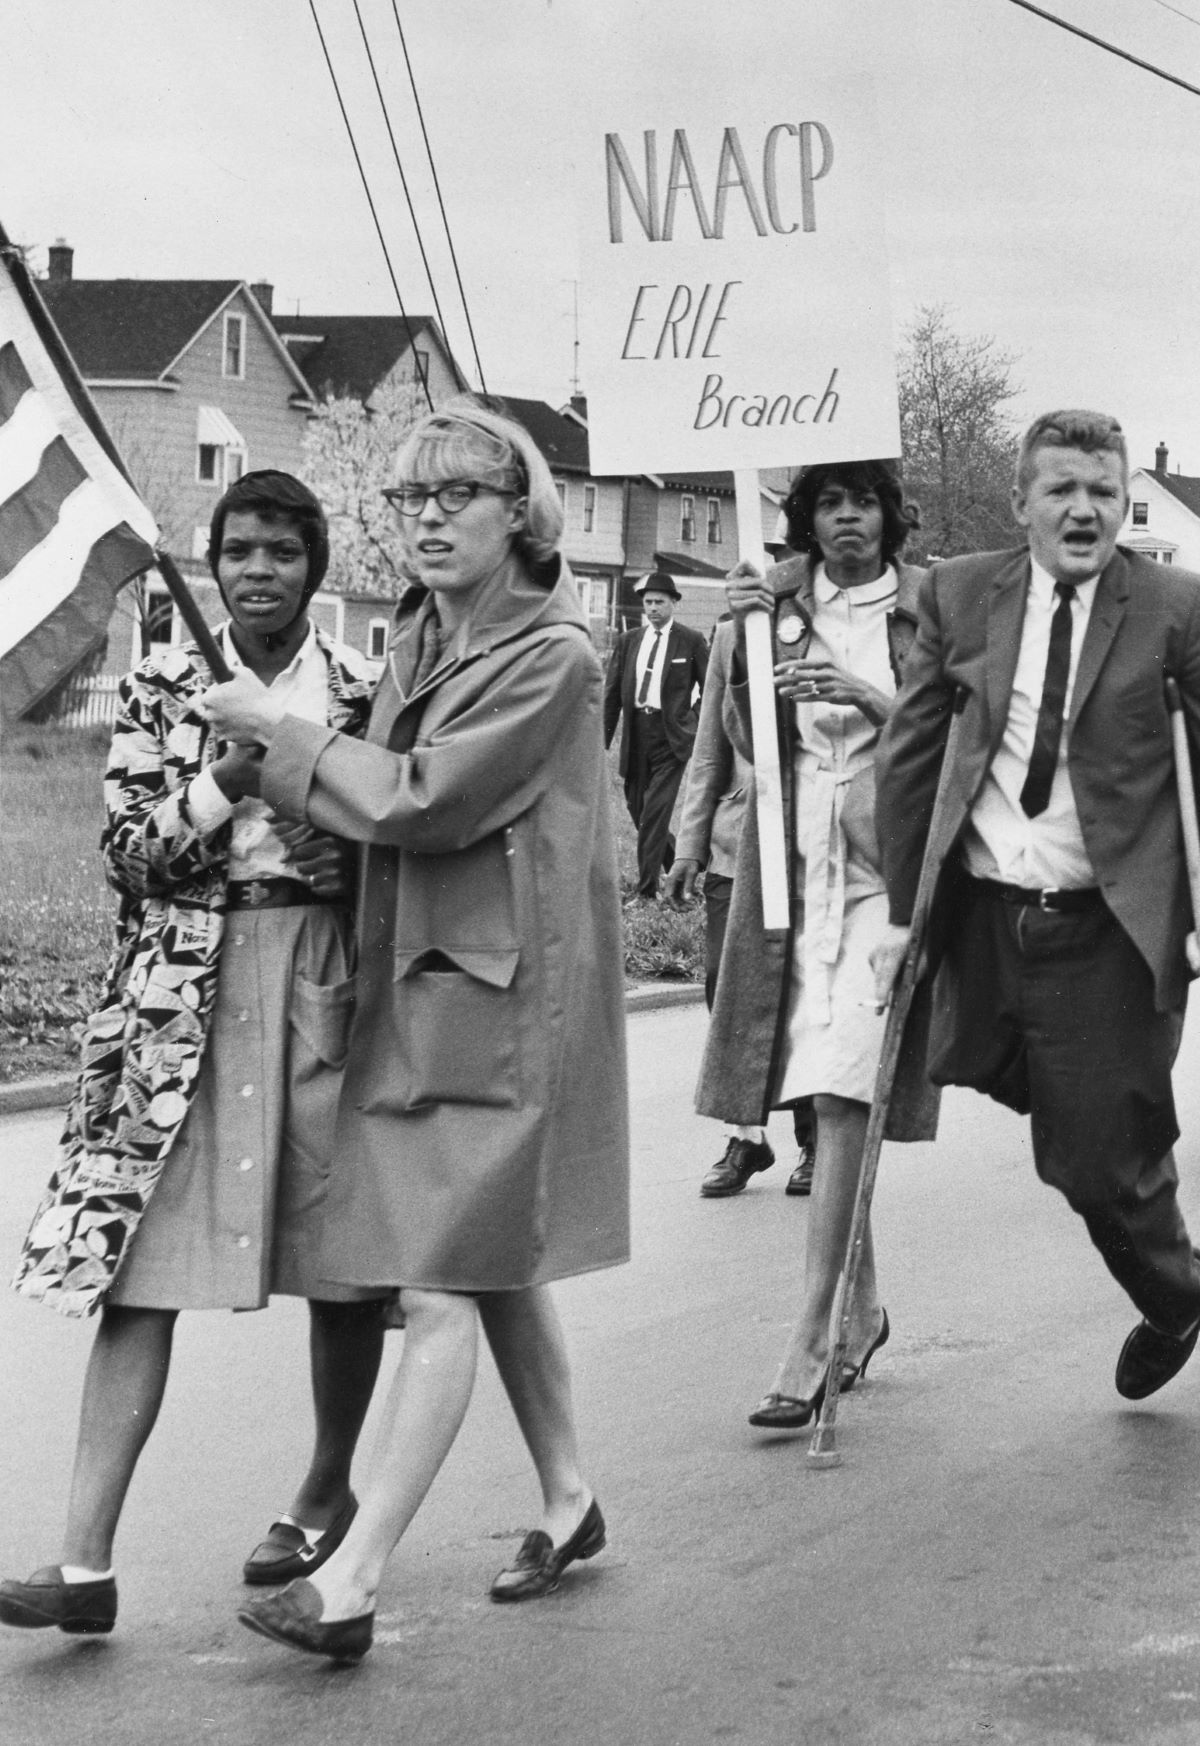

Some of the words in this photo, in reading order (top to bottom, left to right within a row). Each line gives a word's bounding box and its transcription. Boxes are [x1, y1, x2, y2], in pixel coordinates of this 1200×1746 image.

[605, 121, 834, 243] NAACP
[621, 281, 742, 360] ERIE
[694, 368, 839, 430] Branch
